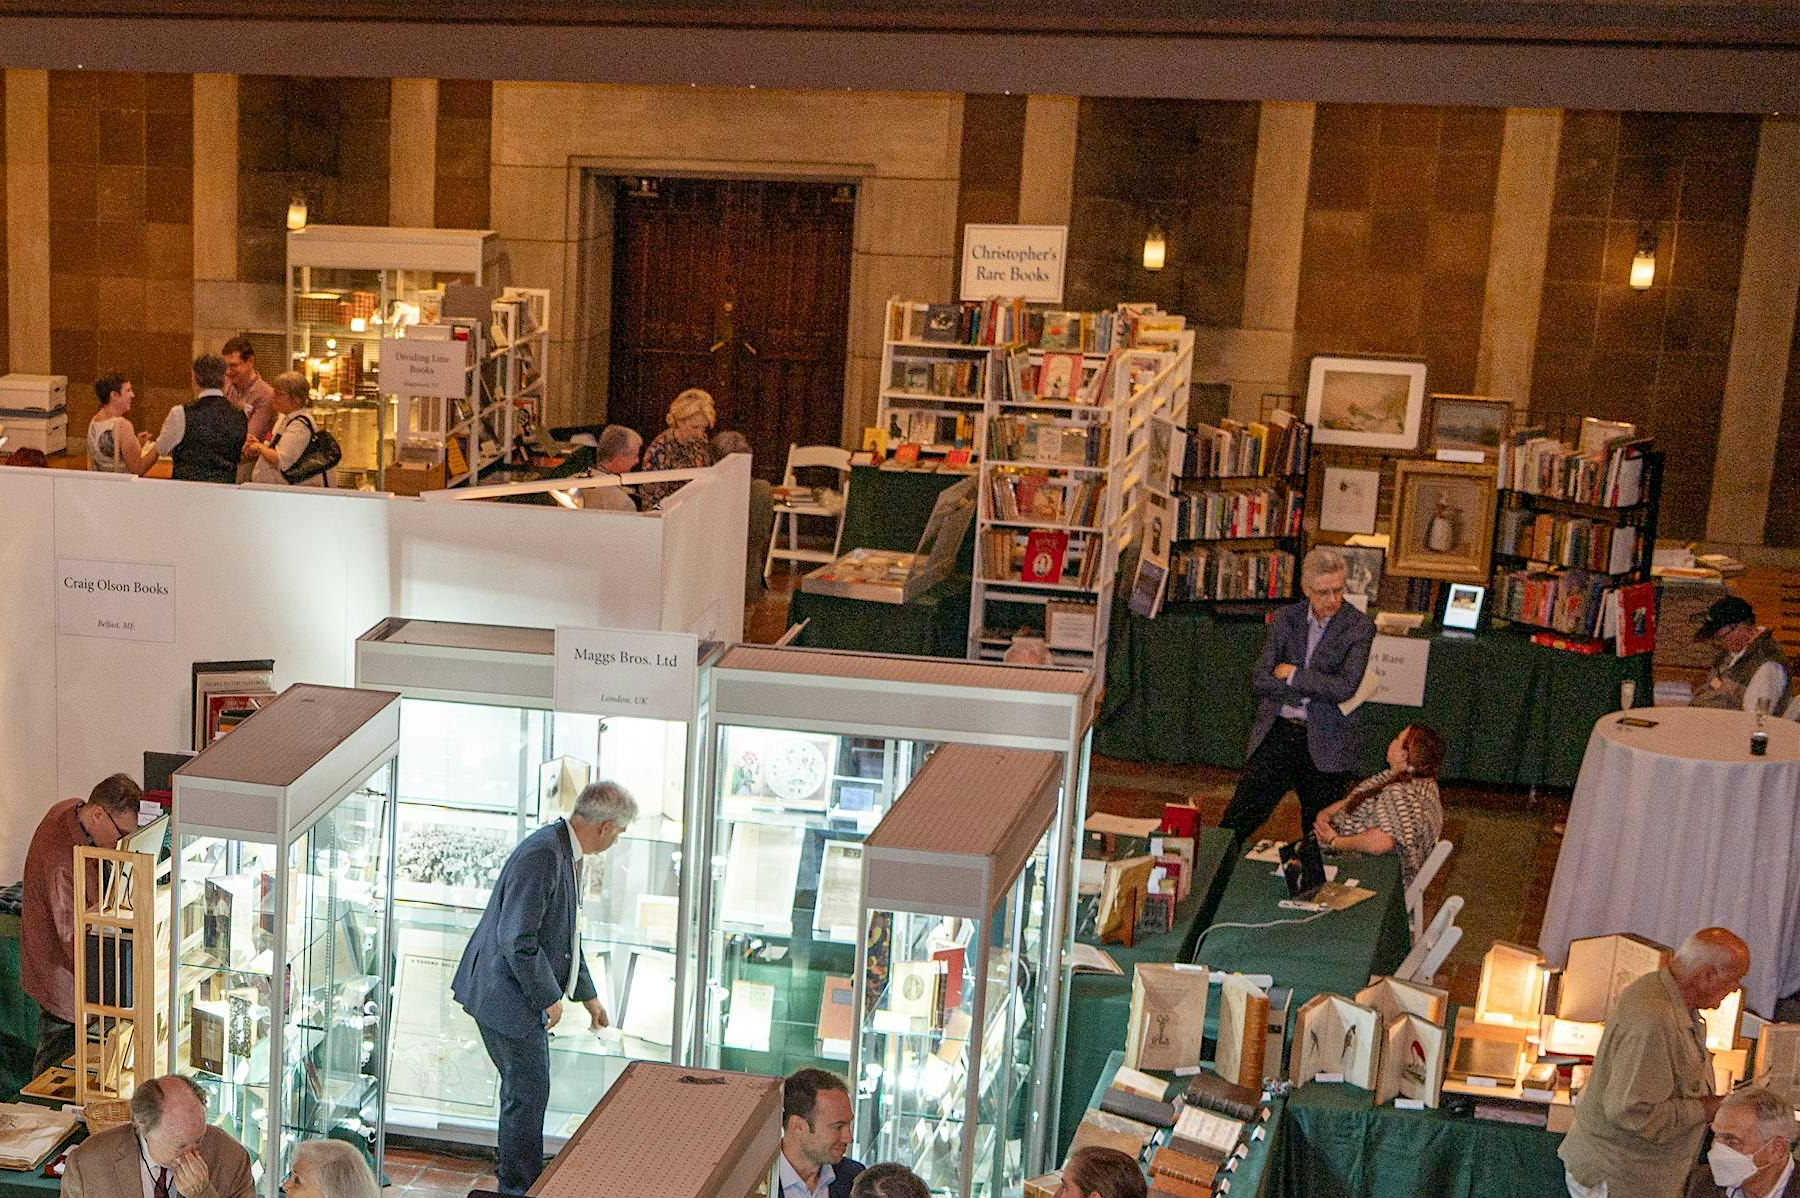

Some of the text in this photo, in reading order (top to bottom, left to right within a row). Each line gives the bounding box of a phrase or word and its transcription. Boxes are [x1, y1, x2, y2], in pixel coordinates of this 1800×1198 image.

[972, 244, 1057, 263] Christopher's
[976, 266, 1049, 281] Rare Books
[63, 576, 169, 595] Craig Olson Books
[574, 648, 678, 667] Maggs Bros. Ltd
[600, 694, 648, 705] London, UK
